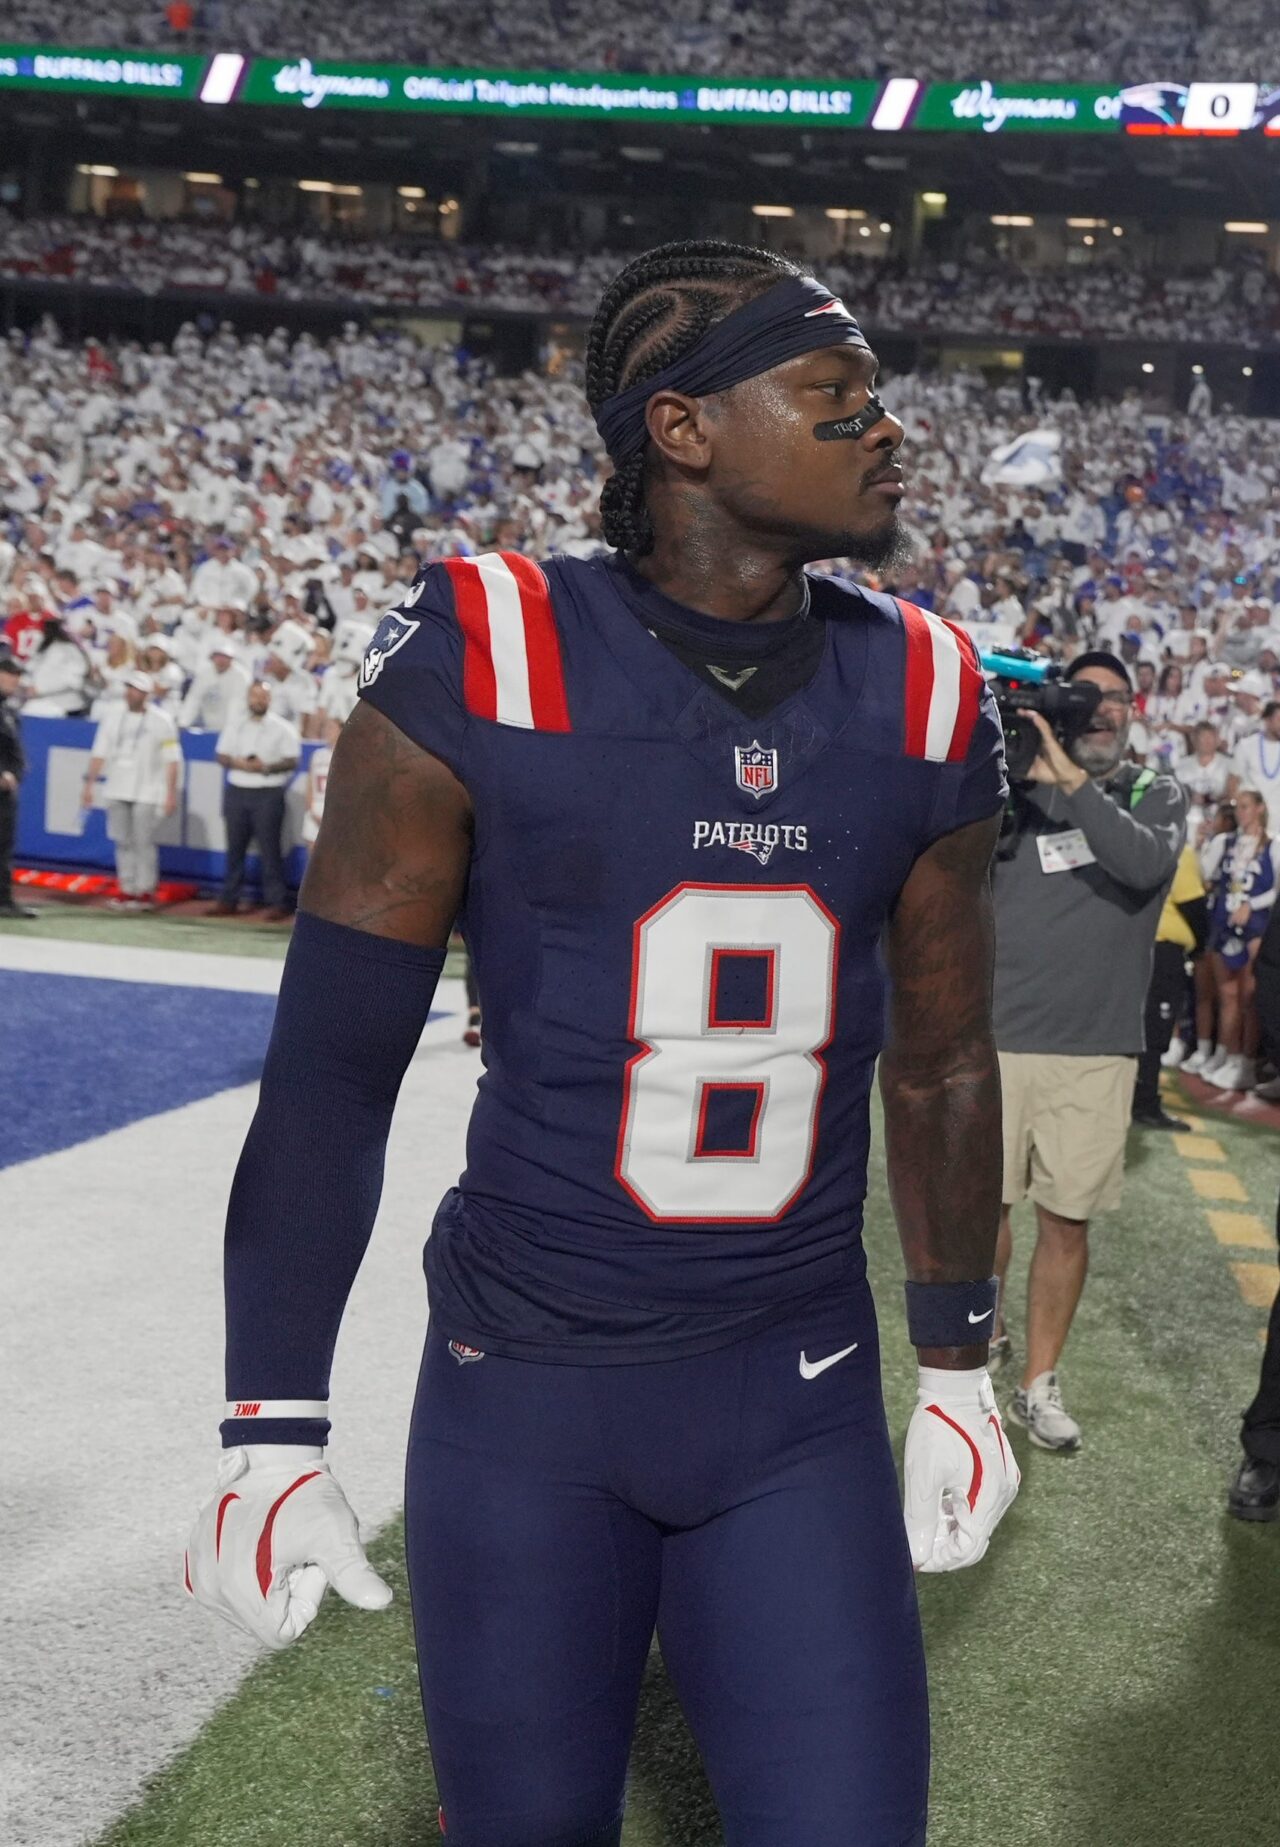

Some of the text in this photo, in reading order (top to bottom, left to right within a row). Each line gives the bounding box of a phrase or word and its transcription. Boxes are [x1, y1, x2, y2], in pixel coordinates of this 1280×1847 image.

[34, 55, 121, 83] BUFFALO
[272, 57, 390, 108] Wegmans
[403, 76, 473, 101] Official
[474, 79, 548, 107] Tailgate
[550, 82, 678, 110] Headquarters
[697, 87, 788, 113] BUFFALO
[950, 80, 1077, 132] Wegmans
[1211, 95, 1229, 118] 0
[743, 766, 773, 788] NFL
[693, 821, 808, 851] PATRIOTS
[613, 882, 842, 1223] 8
[233, 1403, 261, 1417] NIKE
